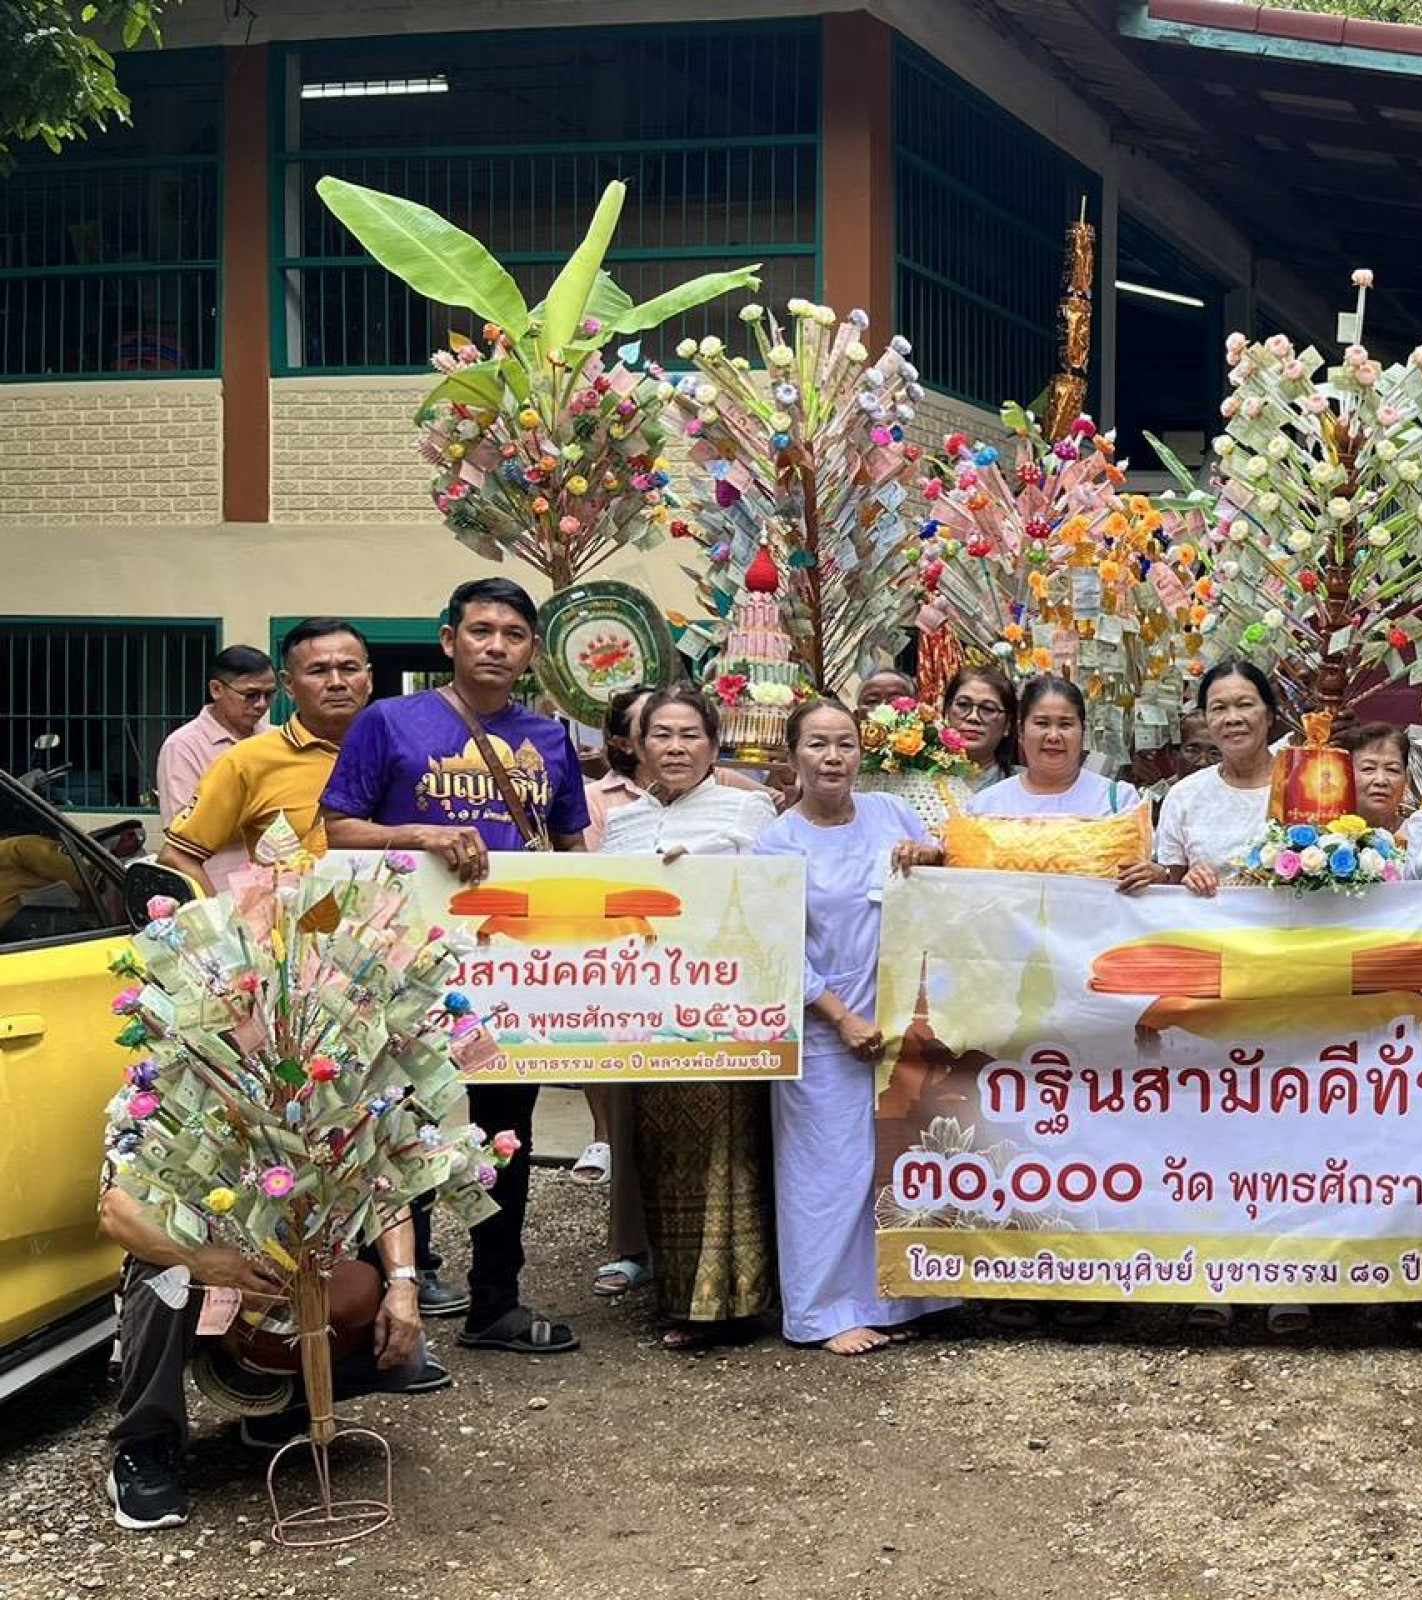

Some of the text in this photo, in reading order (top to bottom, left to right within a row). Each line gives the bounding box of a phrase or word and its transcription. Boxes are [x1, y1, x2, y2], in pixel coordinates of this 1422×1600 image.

[528, 1004, 663, 1037] พุทธศักราช
[673, 1003, 787, 1028] ๒๕๖๘
[515, 1058, 594, 1076] บูชาธรรม
[631, 1053, 643, 1070] ปี
[650, 1050, 781, 1070] หลวงพ่อธัมมชโย
[901, 1158, 1143, 1211] ๓๐,๐๐๐
[1162, 1156, 1214, 1204] วัด
[909, 1247, 962, 1278] โดย
[973, 1249, 1194, 1291] คณะศิษยานุศิษย์
[1205, 1259, 1338, 1292] บูชาธรรม
[1350, 1263, 1390, 1284] ๘๑
[1401, 1252, 1422, 1282] ปี
